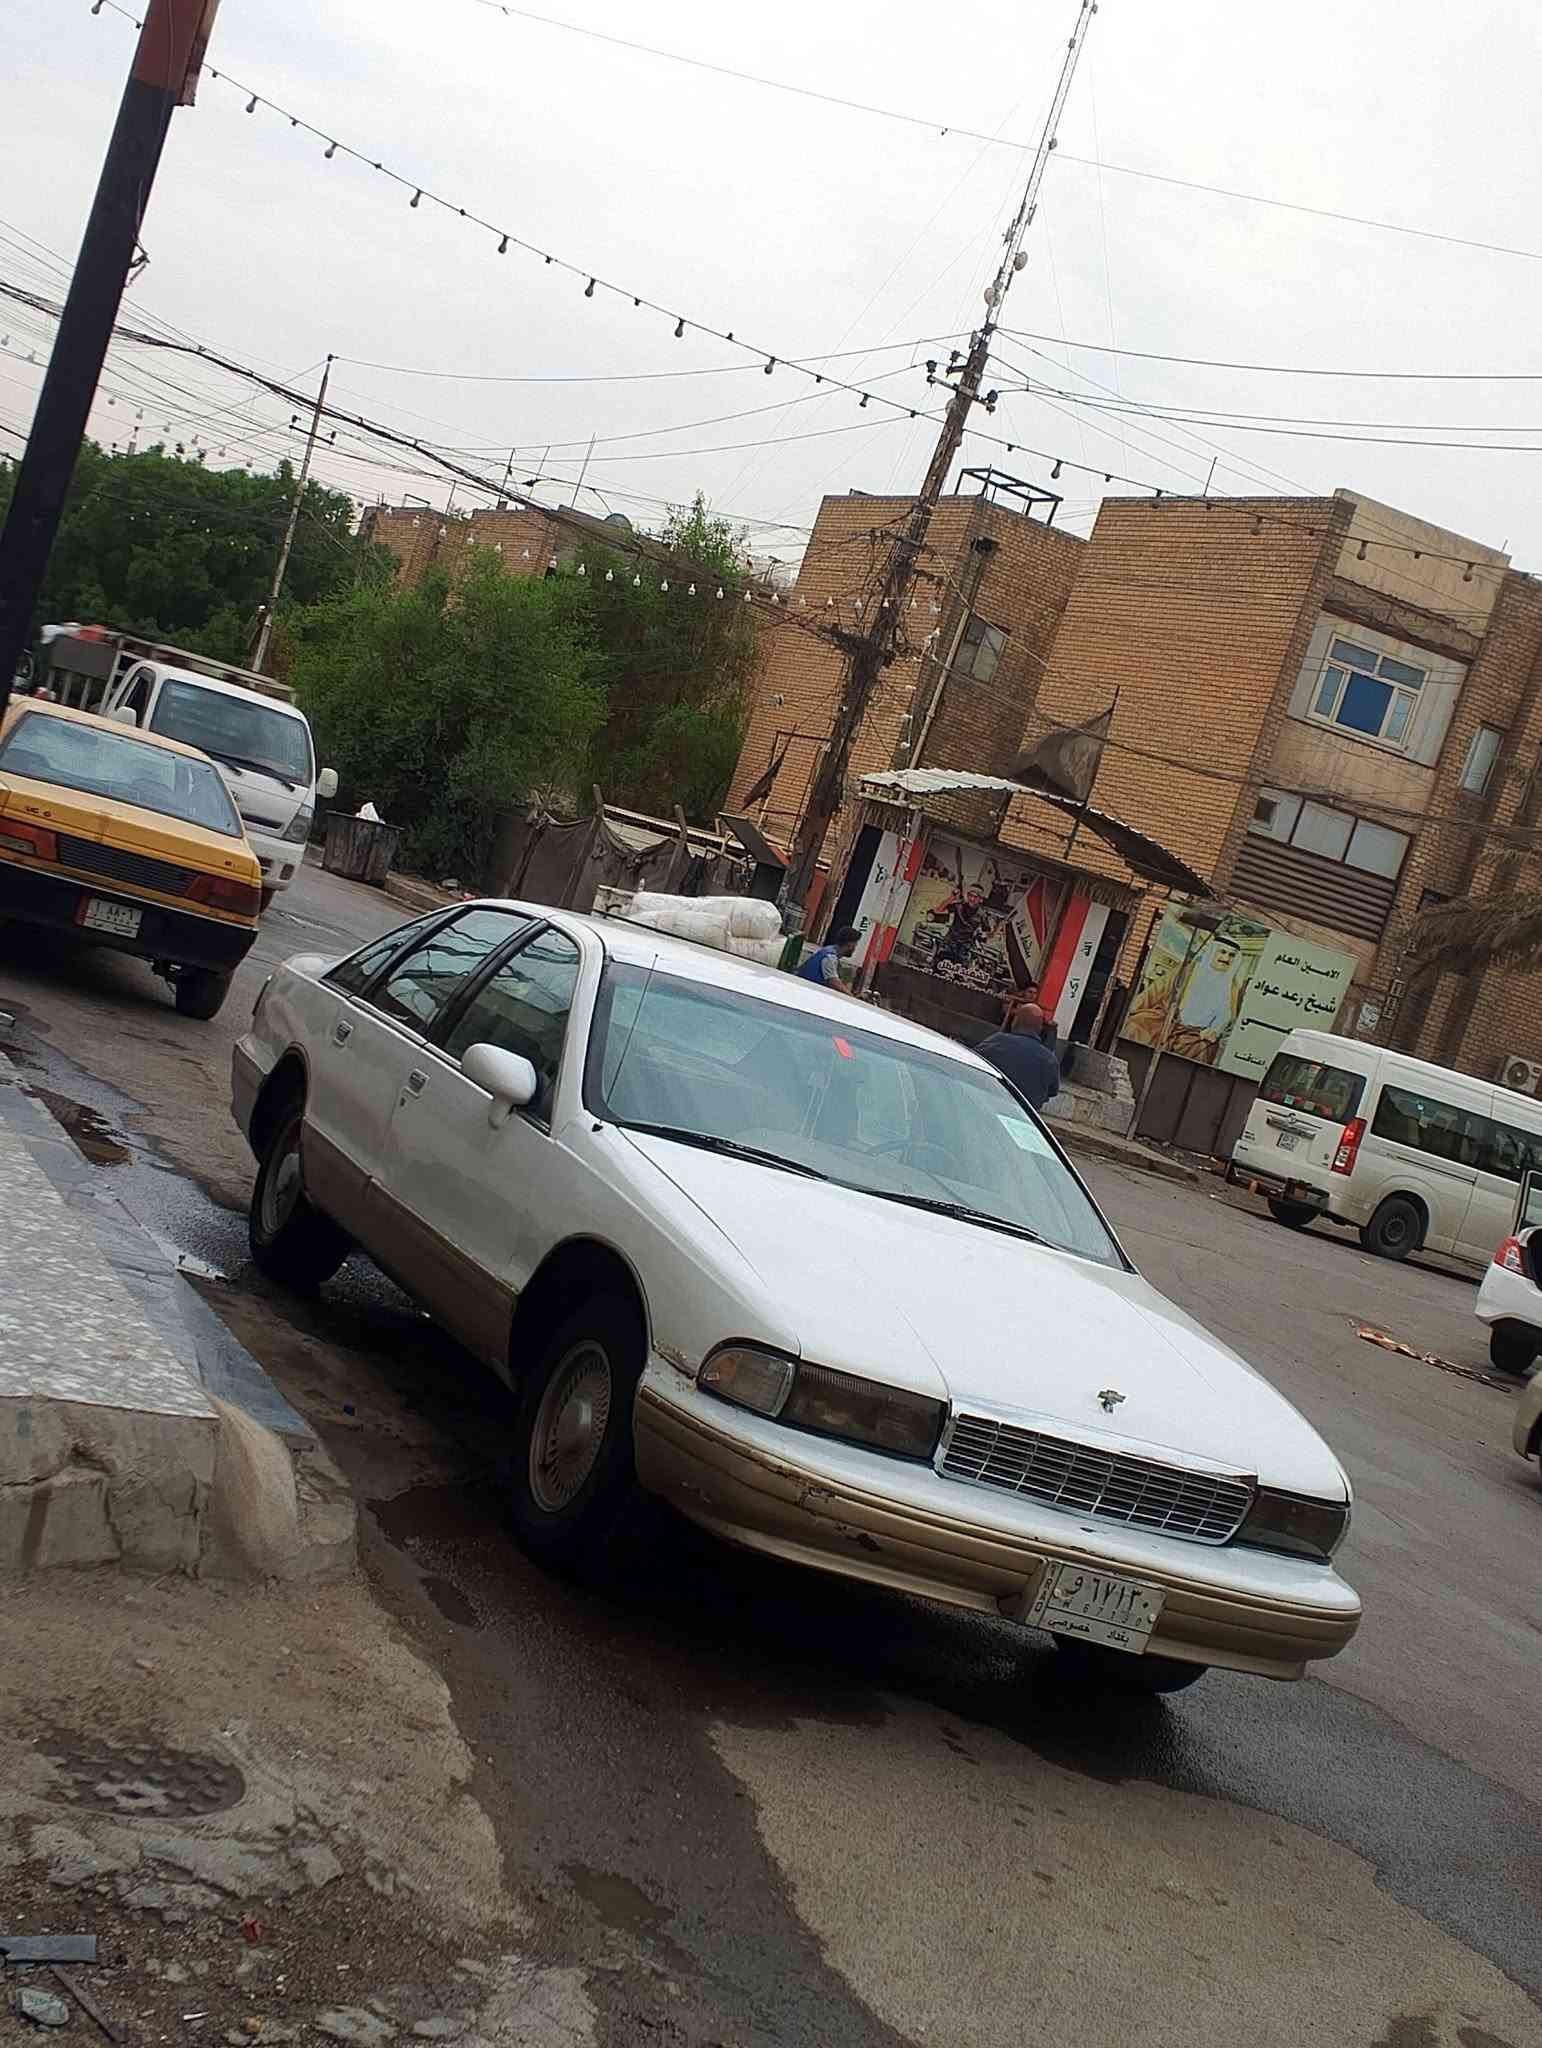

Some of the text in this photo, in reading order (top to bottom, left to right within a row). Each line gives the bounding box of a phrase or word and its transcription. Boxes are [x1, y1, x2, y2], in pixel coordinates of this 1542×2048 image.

[1081, 941, 1093, 957] الله
[1274, 954, 1301, 966] العام
[1254, 980, 1280, 996] عواد
[1281, 990, 1304, 1007] رعد
[1047, 1619, 1130, 1647] بغداد خصوصي
